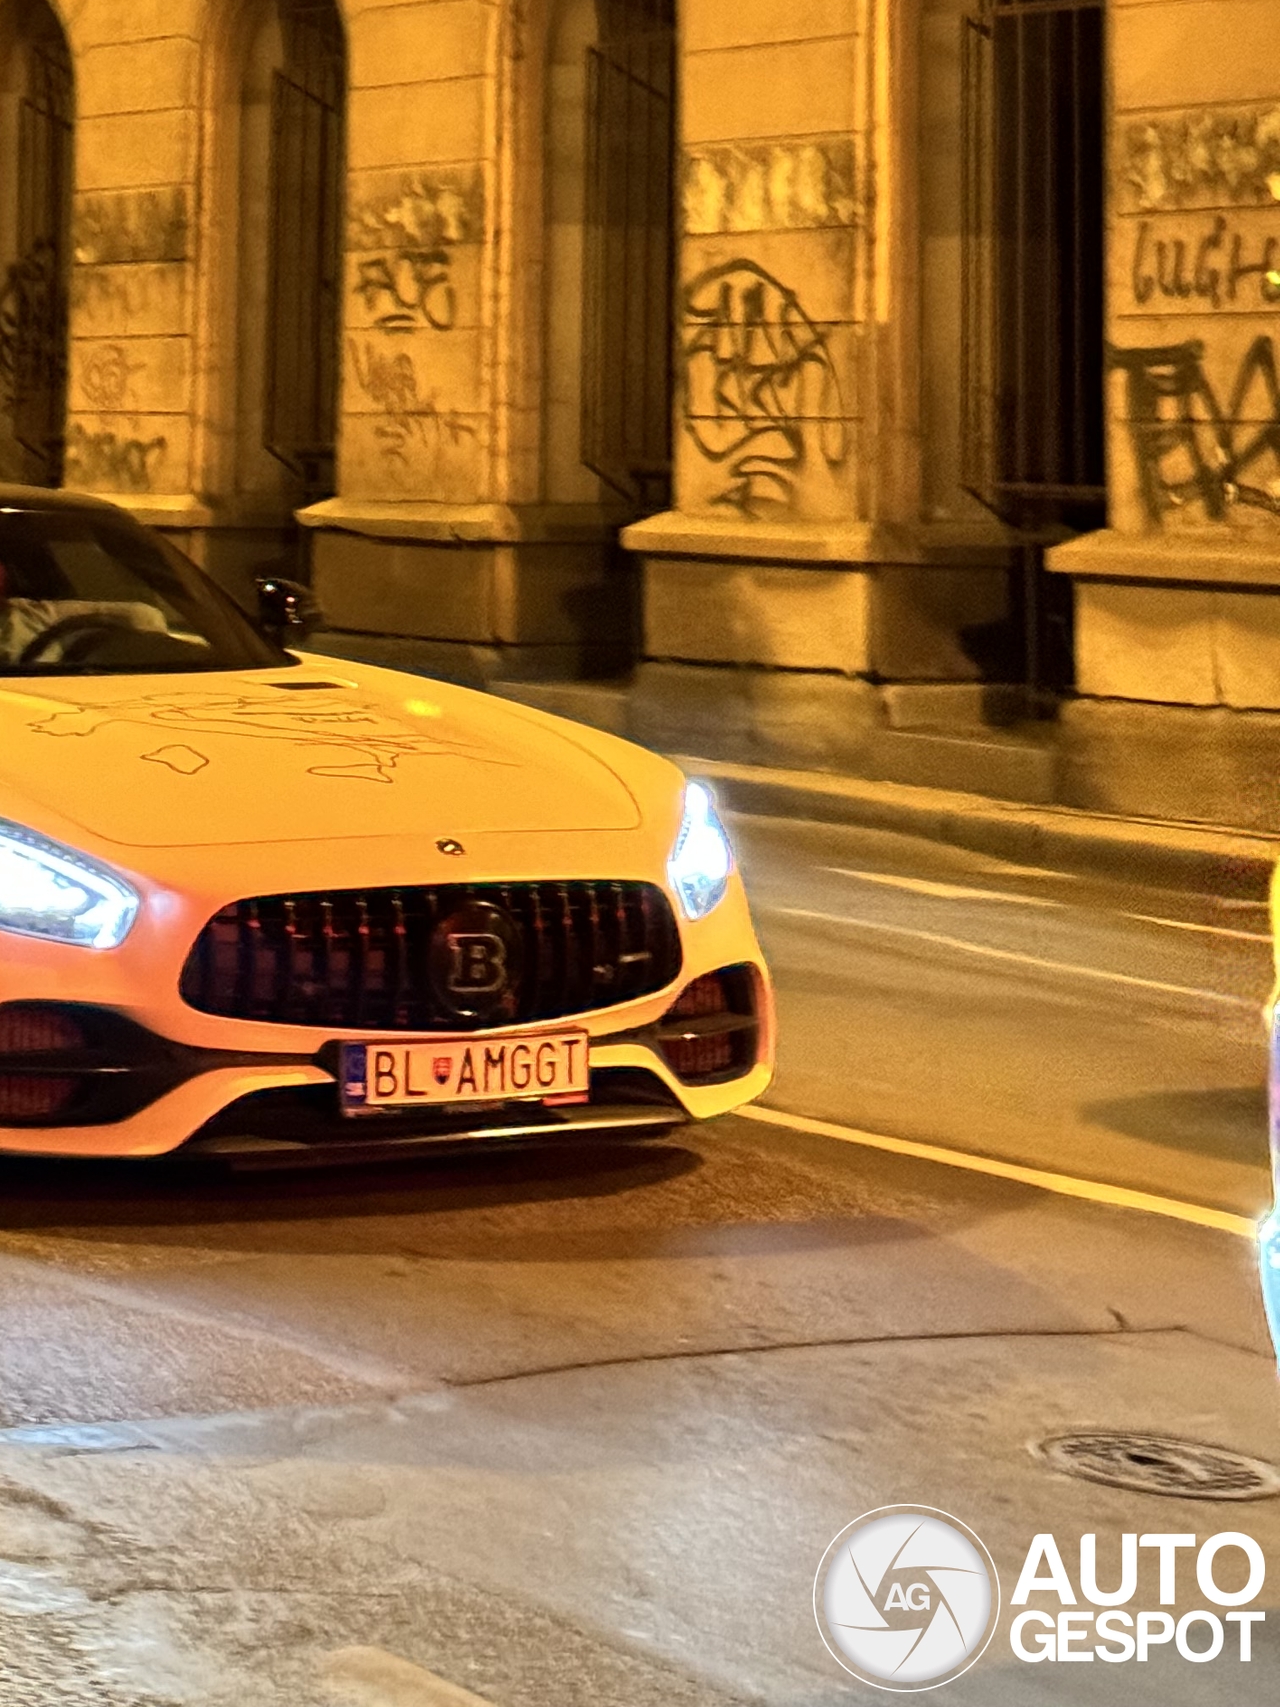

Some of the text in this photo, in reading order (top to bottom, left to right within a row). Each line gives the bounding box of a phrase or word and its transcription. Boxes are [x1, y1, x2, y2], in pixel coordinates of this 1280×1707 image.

[446, 932, 508, 993] B
[375, 1039, 580, 1097] BL AMGGT
